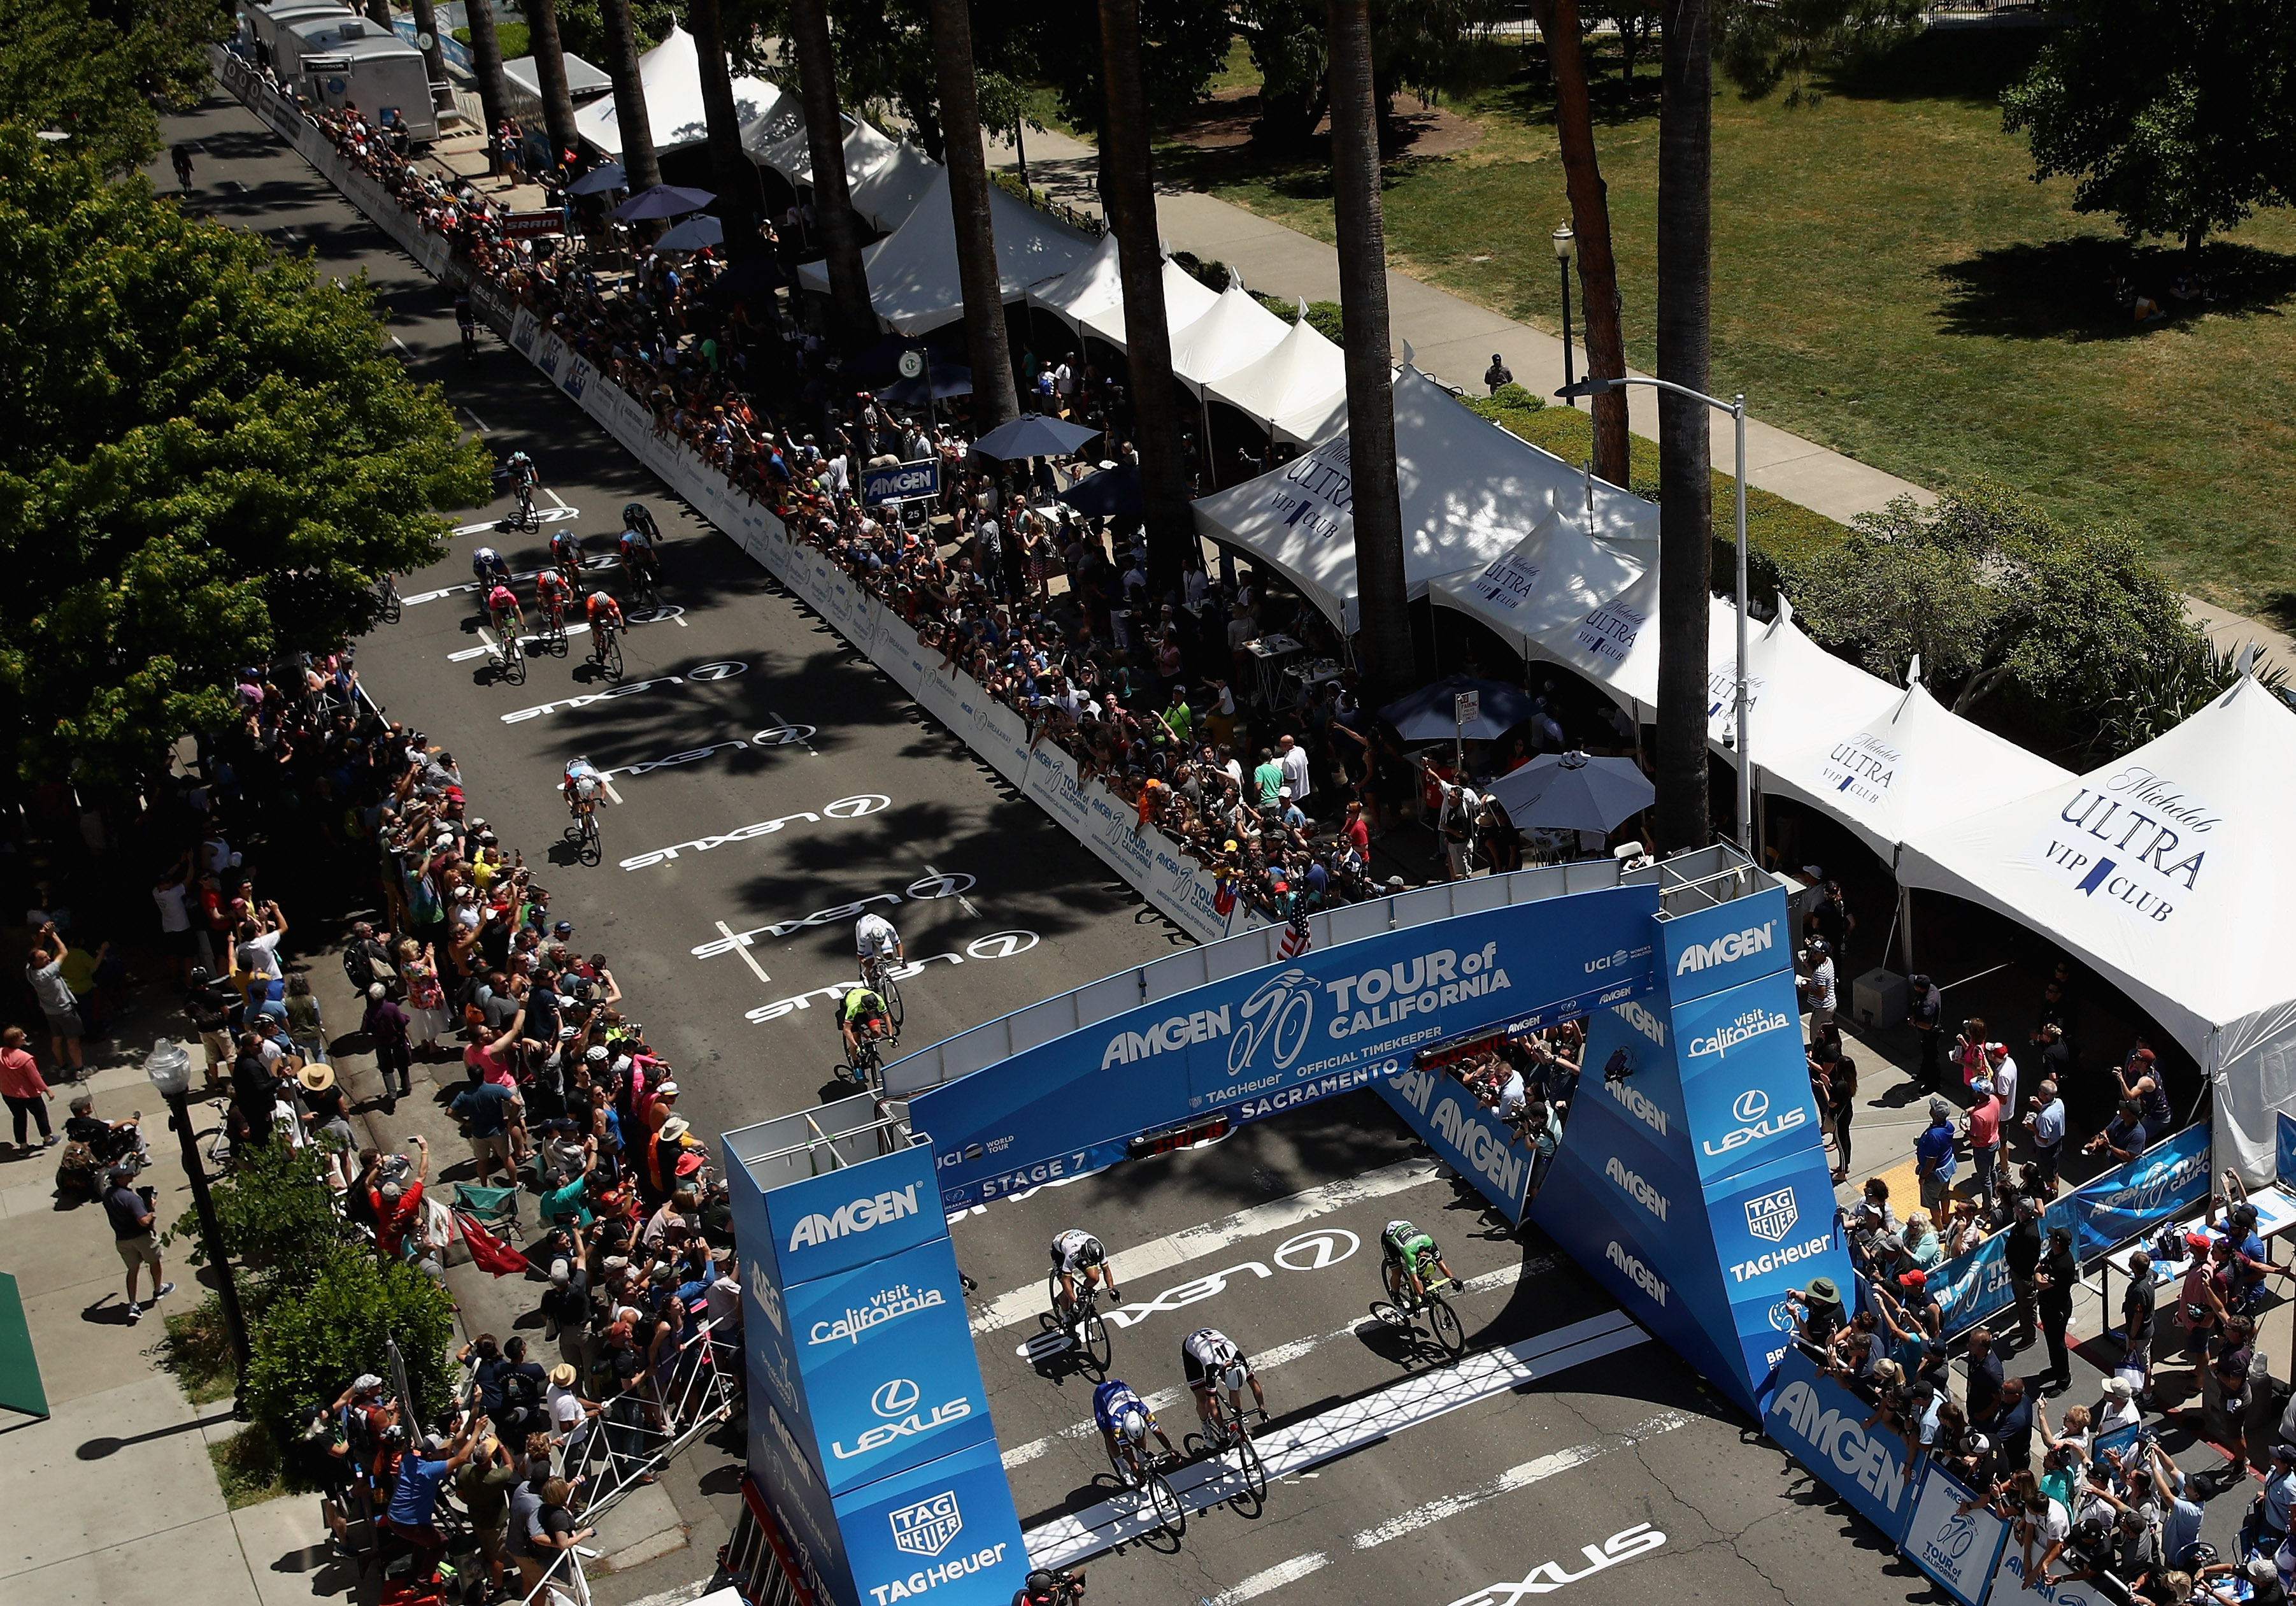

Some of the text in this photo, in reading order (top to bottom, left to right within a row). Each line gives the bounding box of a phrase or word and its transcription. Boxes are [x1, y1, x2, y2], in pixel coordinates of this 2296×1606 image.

[506, 219, 557, 230] SRAM
[868, 470, 931, 497] AMGEN
[908, 510, 920, 519] 25
[1271, 492, 1338, 538] VIP CLUB
[1476, 582, 1518, 608] VIP CLUB
[1485, 563, 1533, 598] ULTRA
[1586, 610, 1638, 648] ULTRA
[1604, 599, 1646, 624] Michelob
[1579, 631, 1624, 661] VIP CLUB
[500, 676, 684, 724] LEXUS
[1033, 748, 1053, 770] AMGEN
[1851, 733, 1902, 762] Michelob
[1830, 743, 1894, 788] ULTRA
[1060, 787, 1088, 816] CALIFORNIA
[1822, 768, 1879, 803] VIP CLUB
[2106, 767, 2223, 833] Michelob
[1091, 798, 1113, 821] AMGEN
[619, 812, 820, 871] LEXUS
[1121, 840, 1152, 871] CALIFORNIA
[1125, 826, 1153, 858] TOUR of
[2061, 788, 2206, 891] ULTRA
[1155, 852, 1180, 877] AMGEN
[2045, 840, 2173, 922] VIP CLUB
[690, 893, 902, 960] LEXUS
[1190, 897, 1226, 929] CALIFORNIA
[1585, 956, 1611, 973] UCI
[1630, 945, 1651, 955] WOMEN'S
[1676, 921, 1773, 976] AMGEN
[1326, 942, 1497, 1013] TOUR of
[1329, 968, 1511, 1039] CALIFORNIA
[1599, 986, 1632, 1005] AMGEN
[1508, 1015, 1541, 1035] AMGEN
[1688, 1012, 1790, 1059] California
[1734, 1008, 1764, 1028] visit
[1101, 1004, 1231, 1070] AMGEN
[1296, 1026, 1441, 1078] OFFICIAL TIMEKEEPER
[1241, 1059, 1399, 1119] SACRAMENTO
[1604, 1081, 1667, 1136] AMGEN
[986, 1135, 1014, 1148] WORLD
[988, 1143, 1009, 1154] TOUR
[1702, 1106, 1806, 1156] LEXUS
[1430, 1098, 1522, 1200] AMGEN
[983, 1159, 1064, 1198] STAGE
[1072, 1152, 1085, 1170] 7
[1605, 1157, 1667, 1222] AMGEN
[2170, 1161, 2211, 1192] CALIFO
[1750, 1192, 1790, 1217] TAG
[2090, 1182, 2139, 1219] AMGEN
[789, 1186, 919, 1252] AMGEN
[1751, 1208, 1795, 1238] HEUER
[1605, 1241, 1666, 1307] AMGEN
[871, 1284, 910, 1307] visit
[808, 1288, 946, 1345] California
[832, 1396, 972, 1459] LEXUS
[1771, 1380, 1906, 1514] AMGEN
[895, 1497, 952, 1529] TAG
[900, 1517, 958, 1551] HEUER
[1922, 1552, 1958, 1586] CALIFORNIA
[1926, 1540, 1962, 1578] TOUR of
